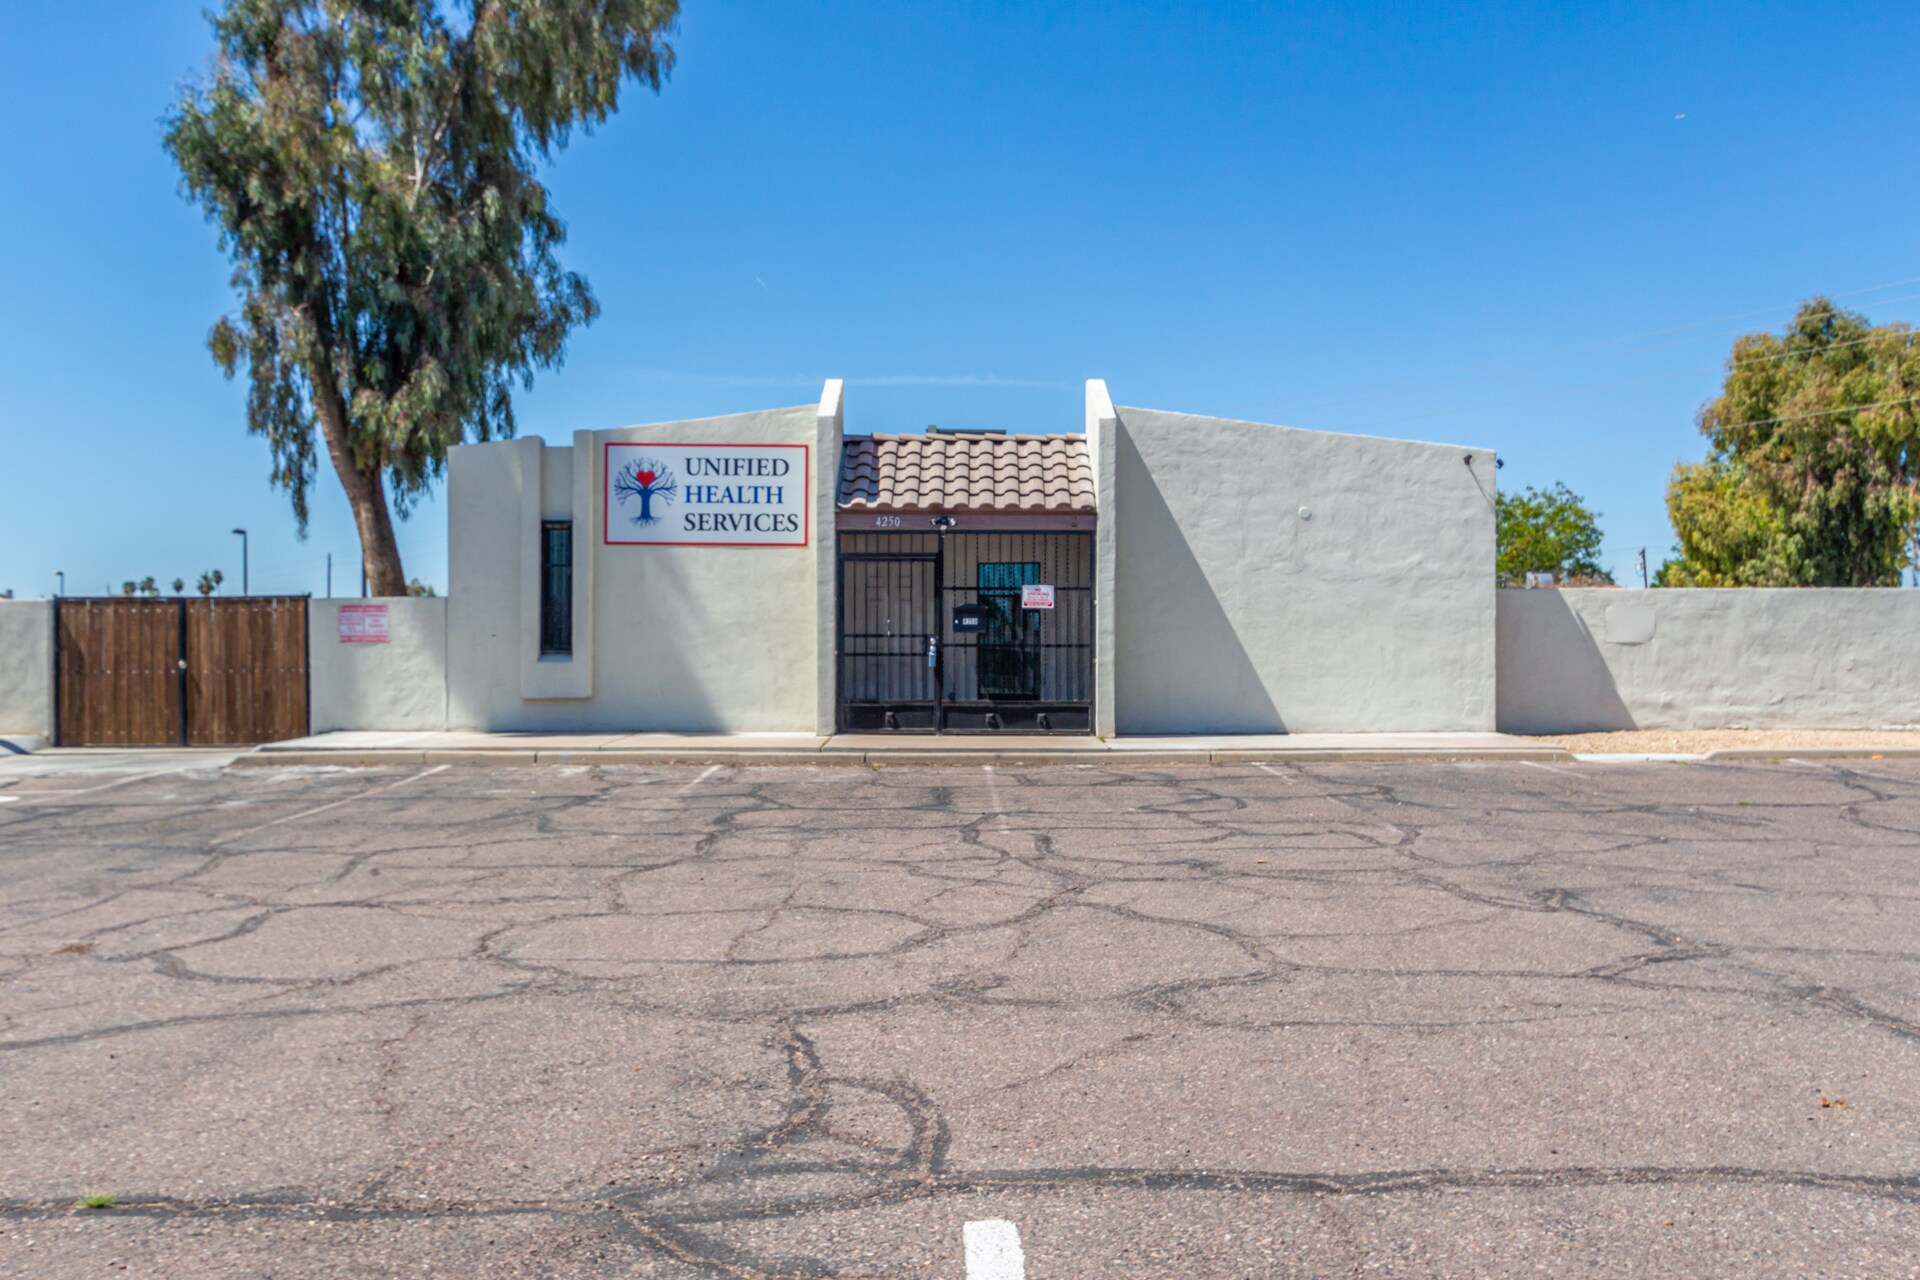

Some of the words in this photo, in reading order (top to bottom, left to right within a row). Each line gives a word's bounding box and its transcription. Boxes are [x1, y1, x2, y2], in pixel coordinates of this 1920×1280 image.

[685, 458, 789, 476] UNIFIED
[685, 486, 784, 504] HEALTH
[684, 513, 798, 532] SERVICES
[875, 515, 900, 527] 4250
